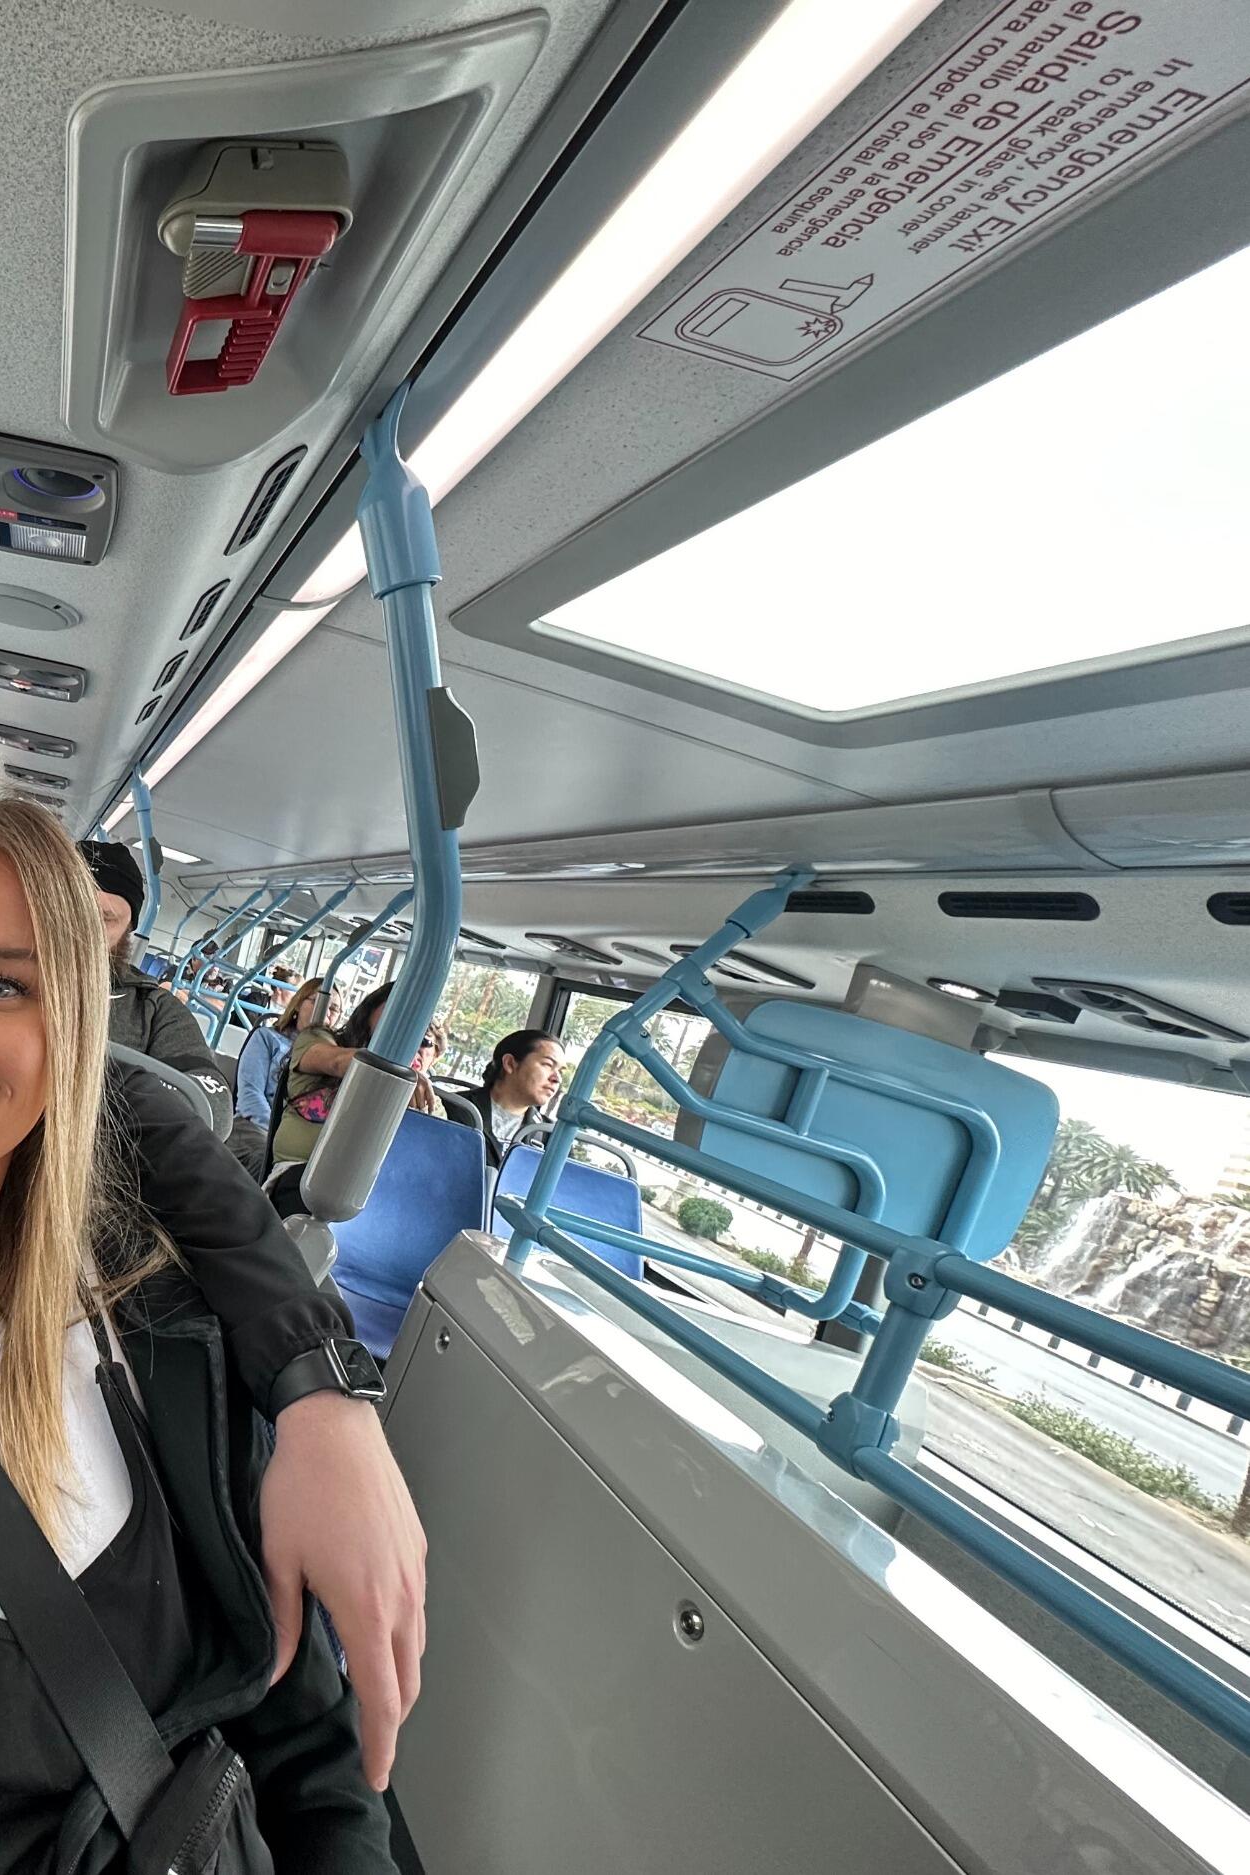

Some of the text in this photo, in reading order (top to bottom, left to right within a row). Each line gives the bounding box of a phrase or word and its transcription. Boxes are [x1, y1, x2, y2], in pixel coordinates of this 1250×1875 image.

[771, 0, 1057, 234] ara romper el cristal en esquina
[776, 1, 1094, 256] el martillo del uso de la emergencia
[820, 10, 1142, 248] Salida de Emergencia
[897, 68, 1134, 237] to break glass in corner
[907, 58, 1194, 254] In emergency, use hammer
[948, 88, 1208, 252] Emergency Exit
